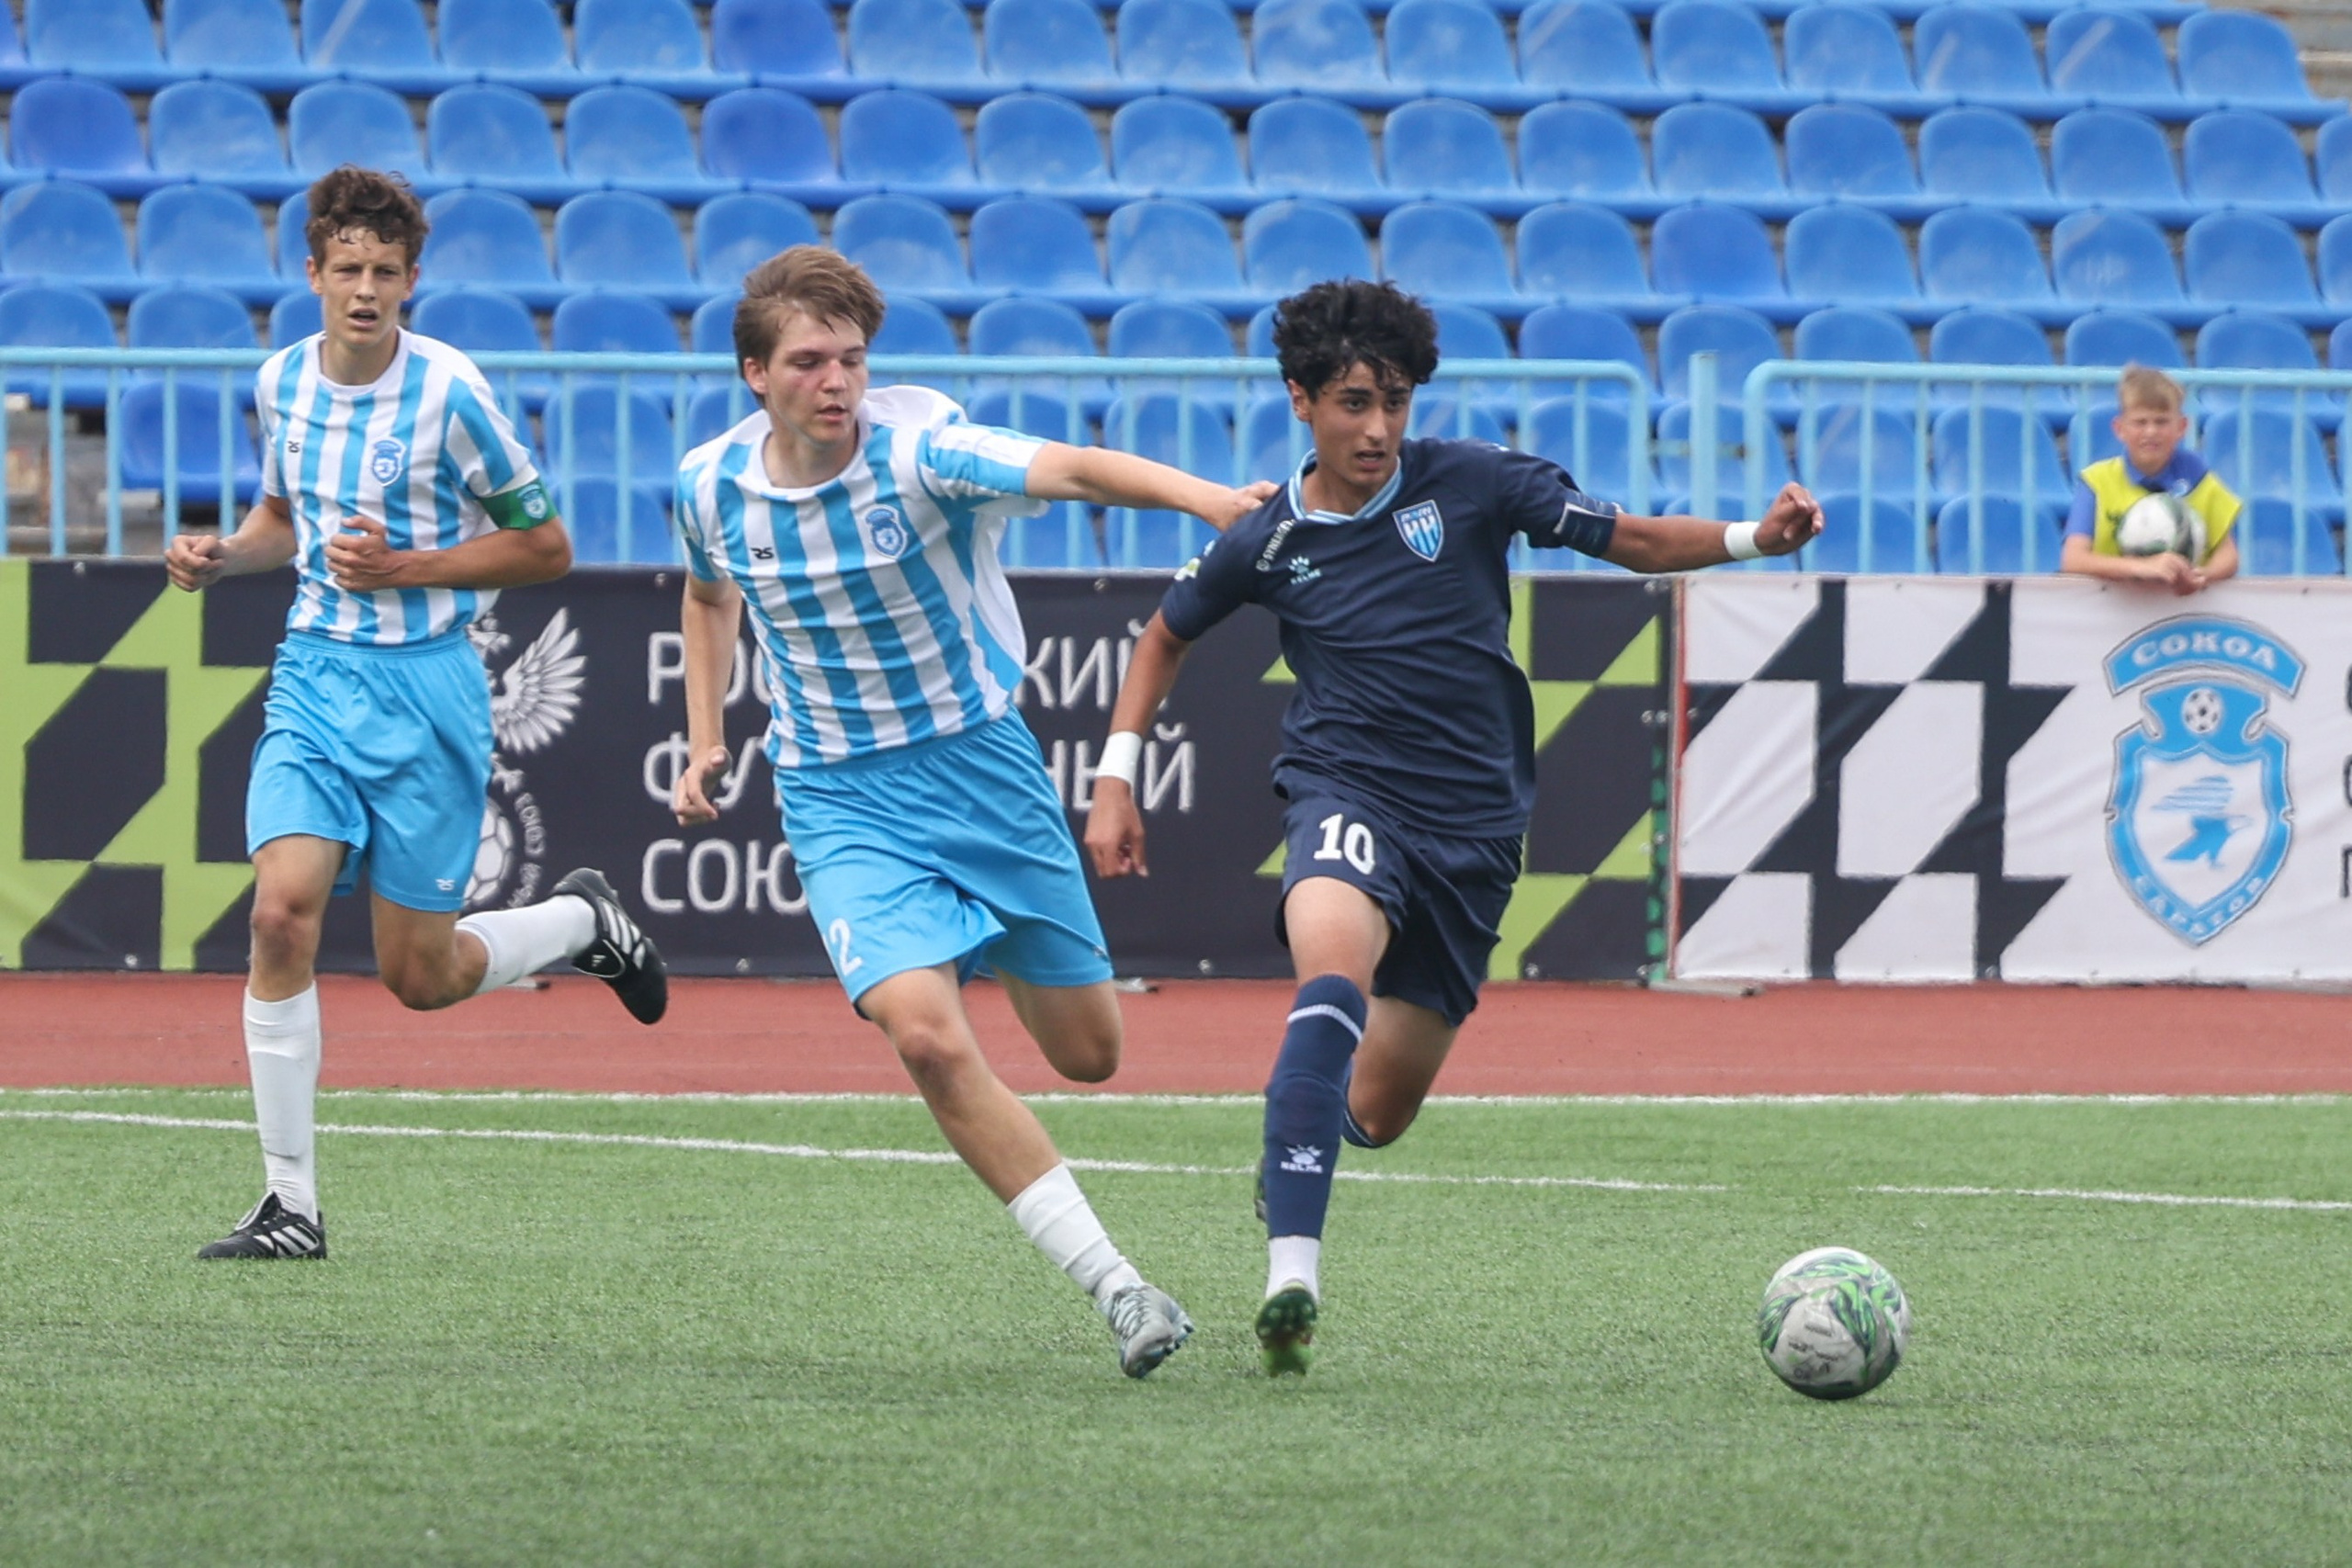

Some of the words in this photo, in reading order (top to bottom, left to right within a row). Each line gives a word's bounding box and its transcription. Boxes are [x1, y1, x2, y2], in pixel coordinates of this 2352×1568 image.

[2132, 630, 2277, 671] СОКОЛ
[1313, 813, 1375, 874] 10
[641, 837, 808, 914] СОЮ
[830, 918, 863, 976] 2
